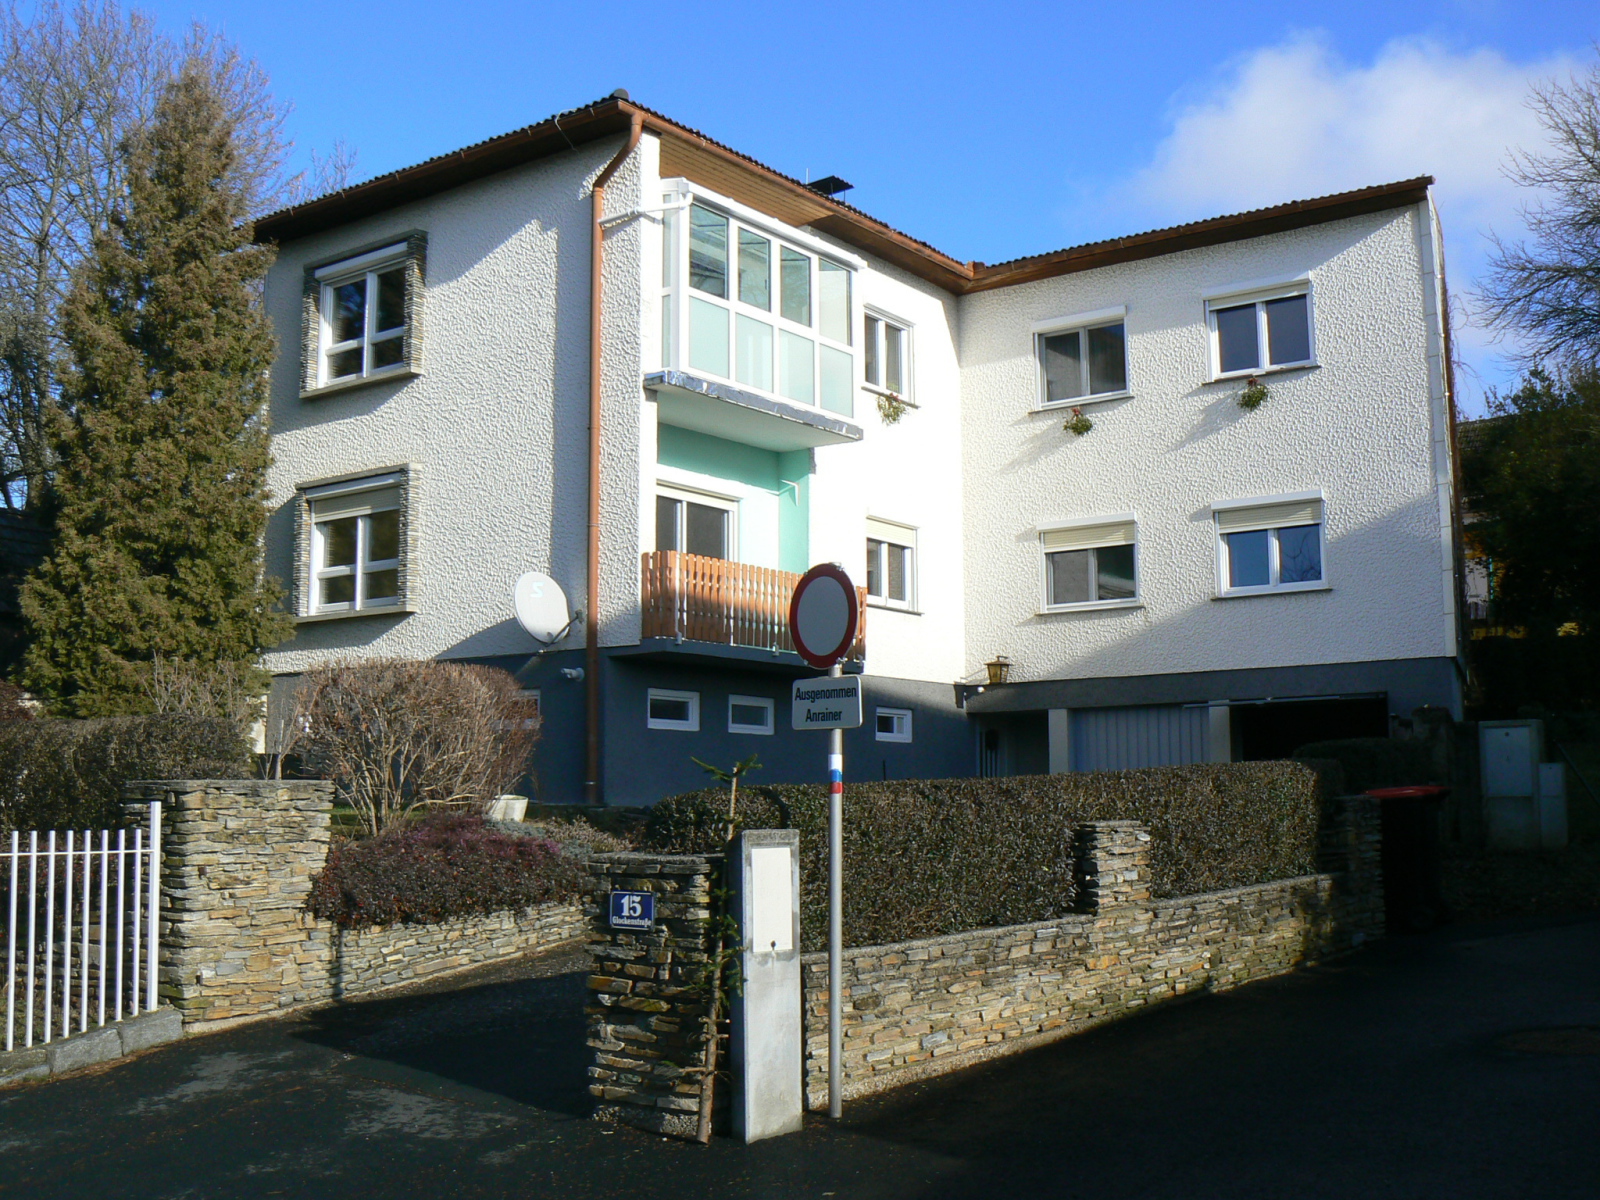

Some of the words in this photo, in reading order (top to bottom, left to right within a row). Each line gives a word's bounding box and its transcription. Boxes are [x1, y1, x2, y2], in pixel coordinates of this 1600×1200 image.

[794, 687, 857, 703] Ausgenommen
[805, 708, 843, 722] Anrainer
[620, 895, 642, 917] 15
